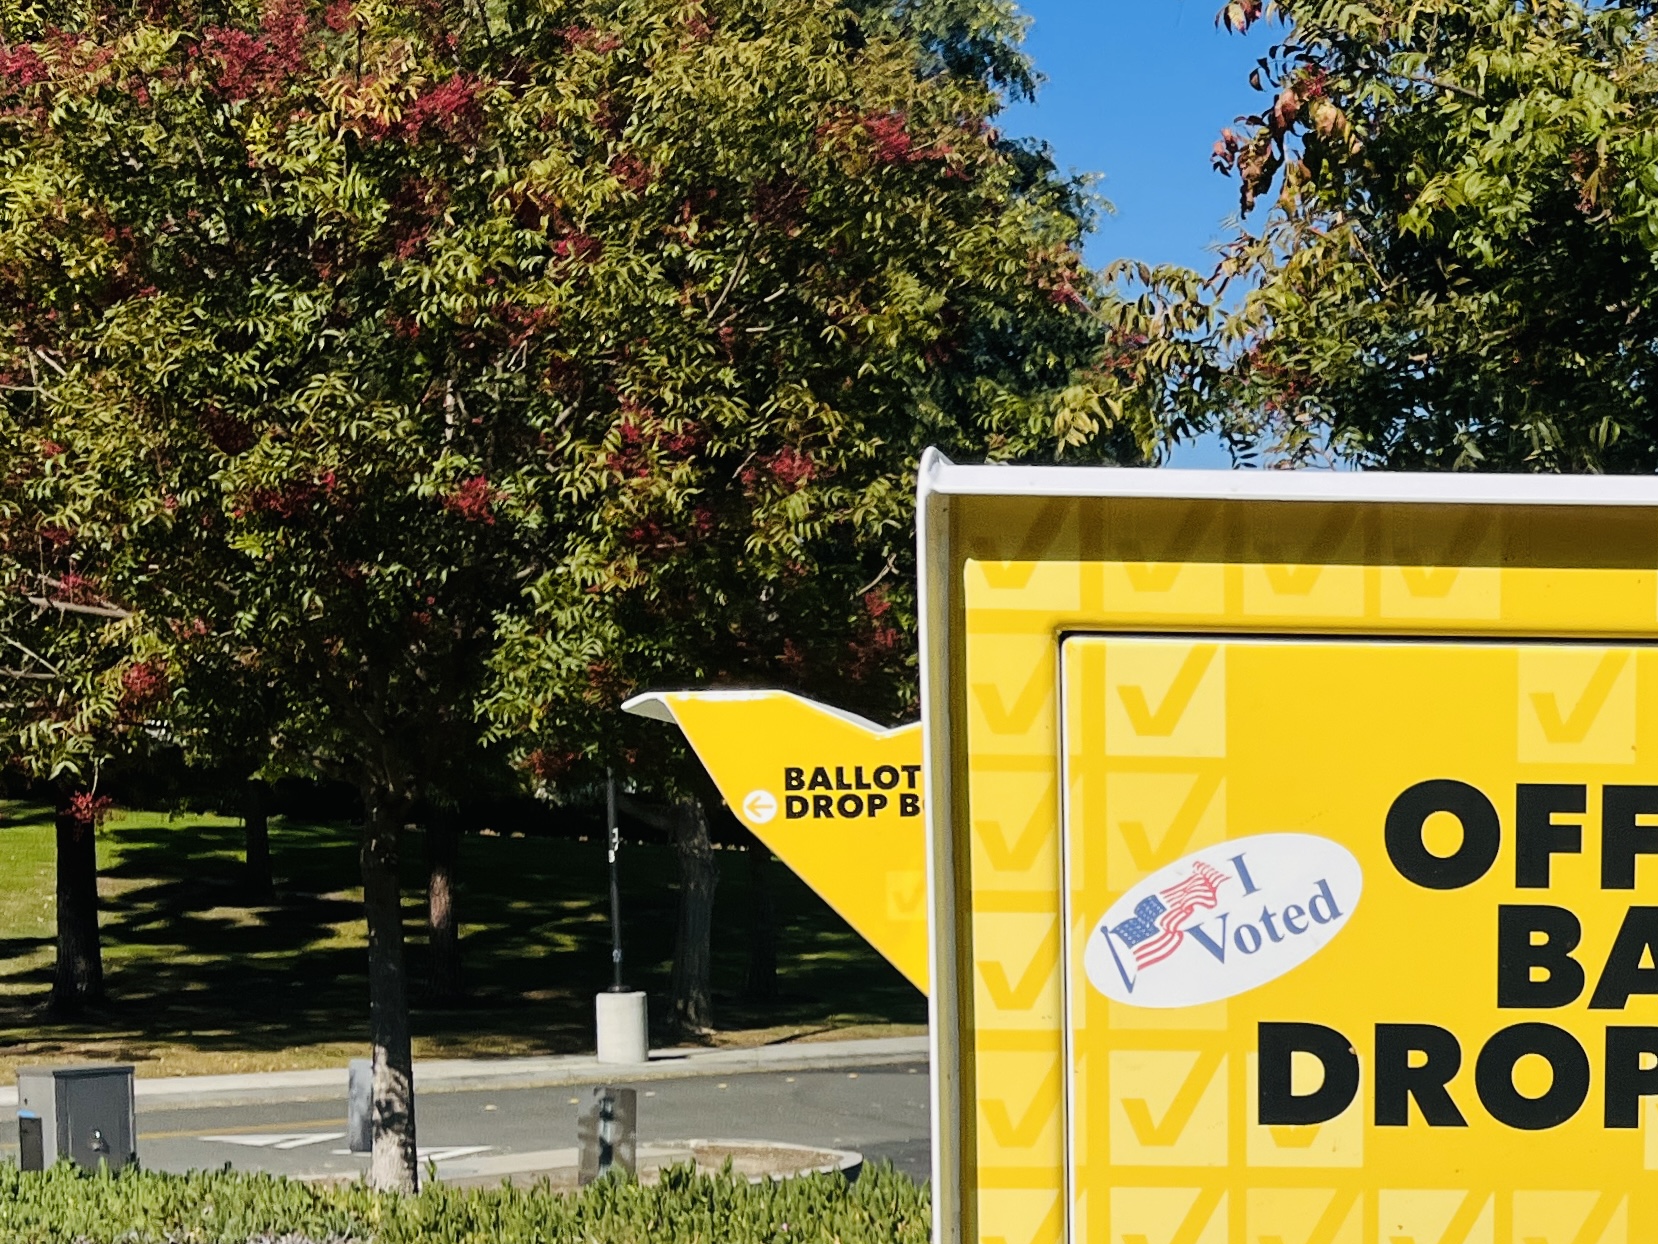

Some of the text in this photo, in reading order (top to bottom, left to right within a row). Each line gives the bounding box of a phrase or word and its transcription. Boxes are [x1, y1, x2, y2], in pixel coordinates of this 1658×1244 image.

[784, 764, 922, 791] BALLOT
[784, 793, 925, 820] DROP B
[1227, 851, 1262, 898] I
[1187, 878, 1345, 966] Voted
